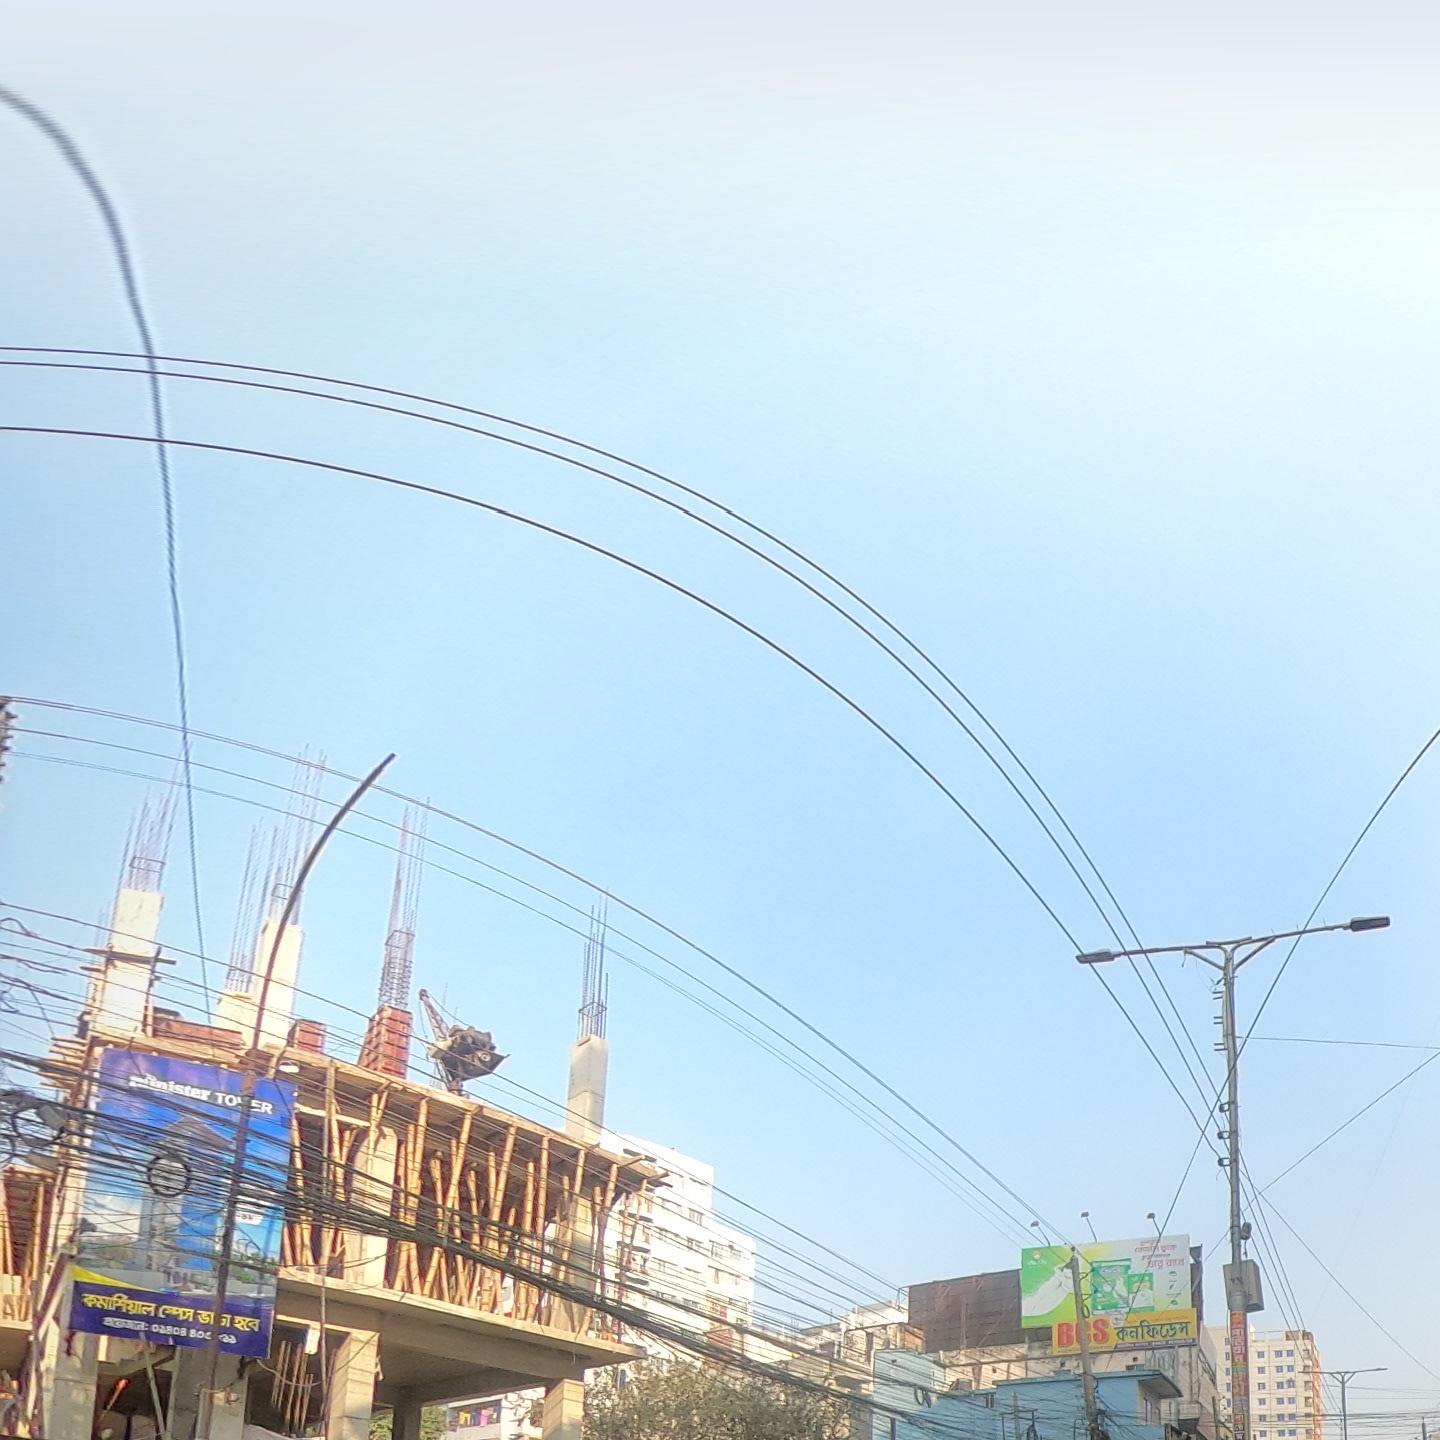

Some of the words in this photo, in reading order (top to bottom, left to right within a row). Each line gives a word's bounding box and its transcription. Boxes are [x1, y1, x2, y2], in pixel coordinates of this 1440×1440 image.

[215, 1092, 273, 1114] TOER
[233, 1313, 260, 1332] হবে
[1115, 1319, 1191, 1341] কনফিডেন্স
